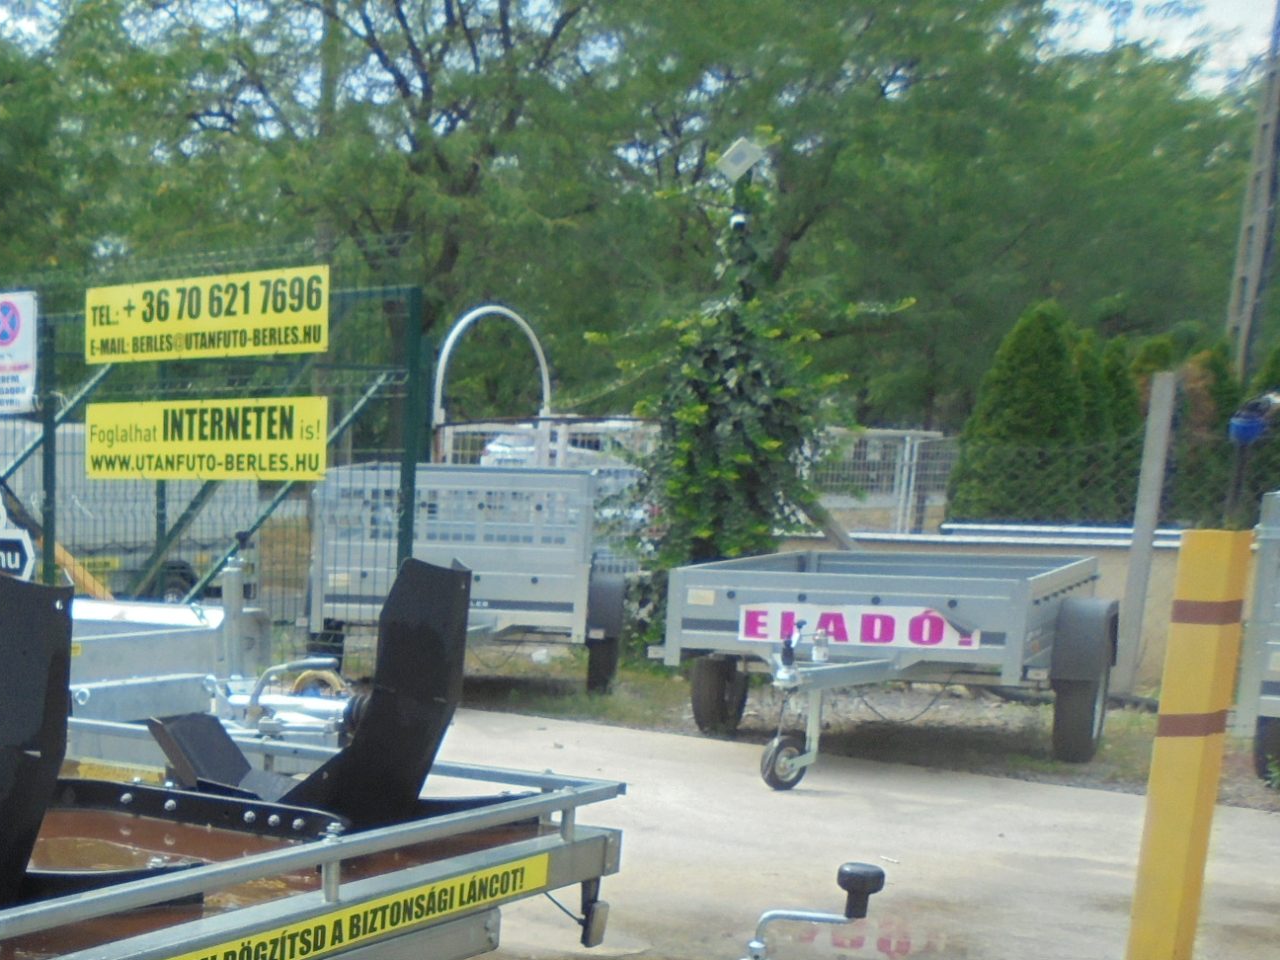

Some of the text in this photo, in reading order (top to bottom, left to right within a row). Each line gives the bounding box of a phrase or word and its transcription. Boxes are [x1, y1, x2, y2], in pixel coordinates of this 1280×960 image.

[91, 305, 119, 327] TEL.:
[176, 285, 202, 320] 70
[208, 281, 251, 318] 621
[260, 274, 323, 315] 7696
[132, 324, 322, 354] BERLES@UTANFUTO-BERLES.HU
[90, 405, 322, 448] Foglalhat INTERNETEN is!
[90, 453, 320, 473] WWW.UTANFUTO-BERLES.HU
[744, 608, 973, 647] ELADÓ
[330, 918, 344, 947] A
[348, 886, 456, 941] BIZTONSÁGI
[458, 866, 526, 908] LÁNCOT!
